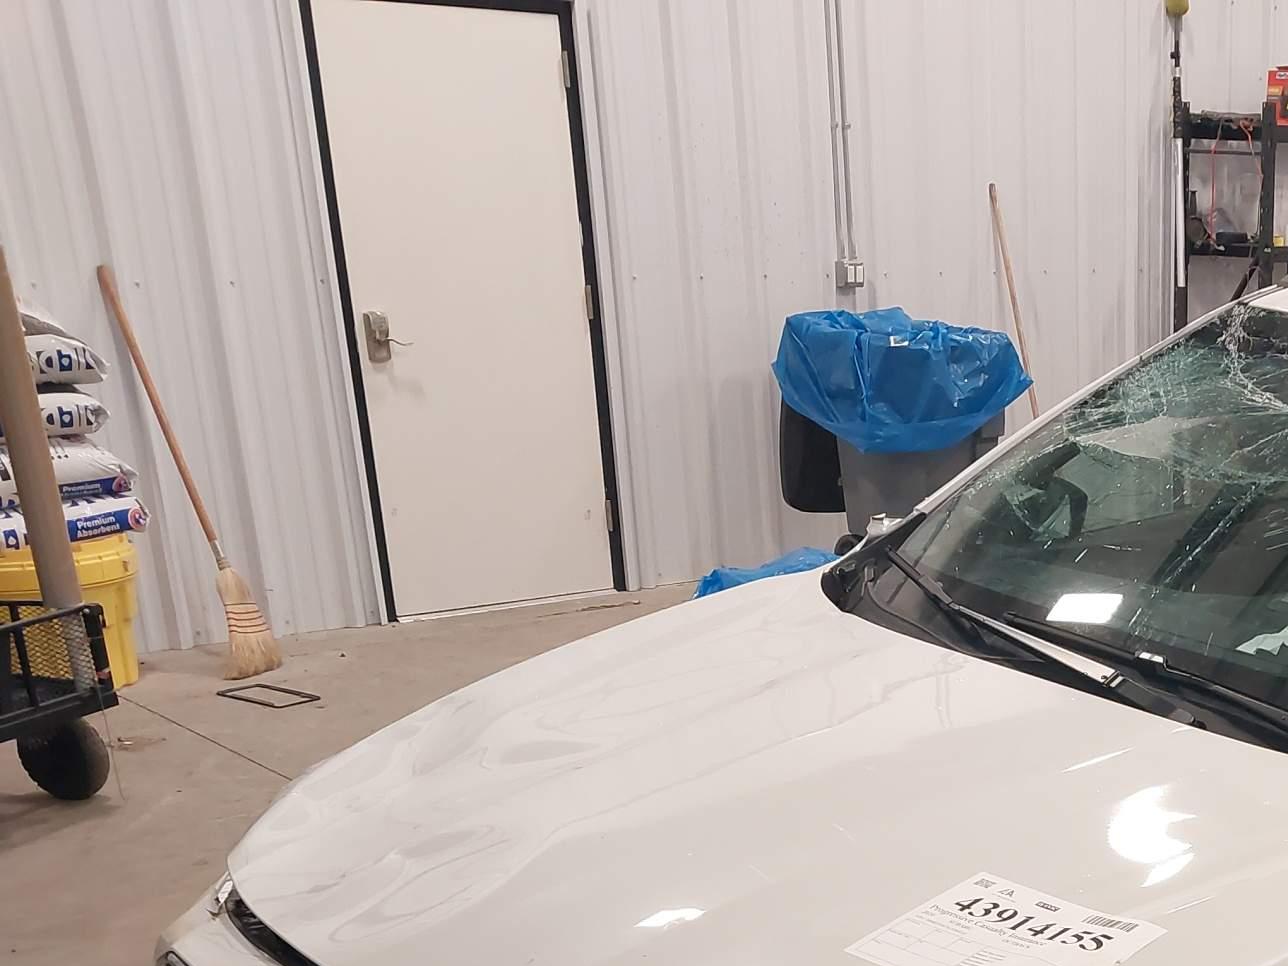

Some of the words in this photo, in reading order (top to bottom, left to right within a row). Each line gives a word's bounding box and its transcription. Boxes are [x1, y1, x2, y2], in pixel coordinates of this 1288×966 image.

[62, 482, 101, 493] Premium
[76, 516, 116, 529] Premium
[77, 524, 120, 539] Absorbent
[929, 904, 974, 924] Progressive
[975, 920, 1007, 936] Casualty
[1008, 932, 1047, 946] Insurance
[954, 896, 1114, 952] 43914155
